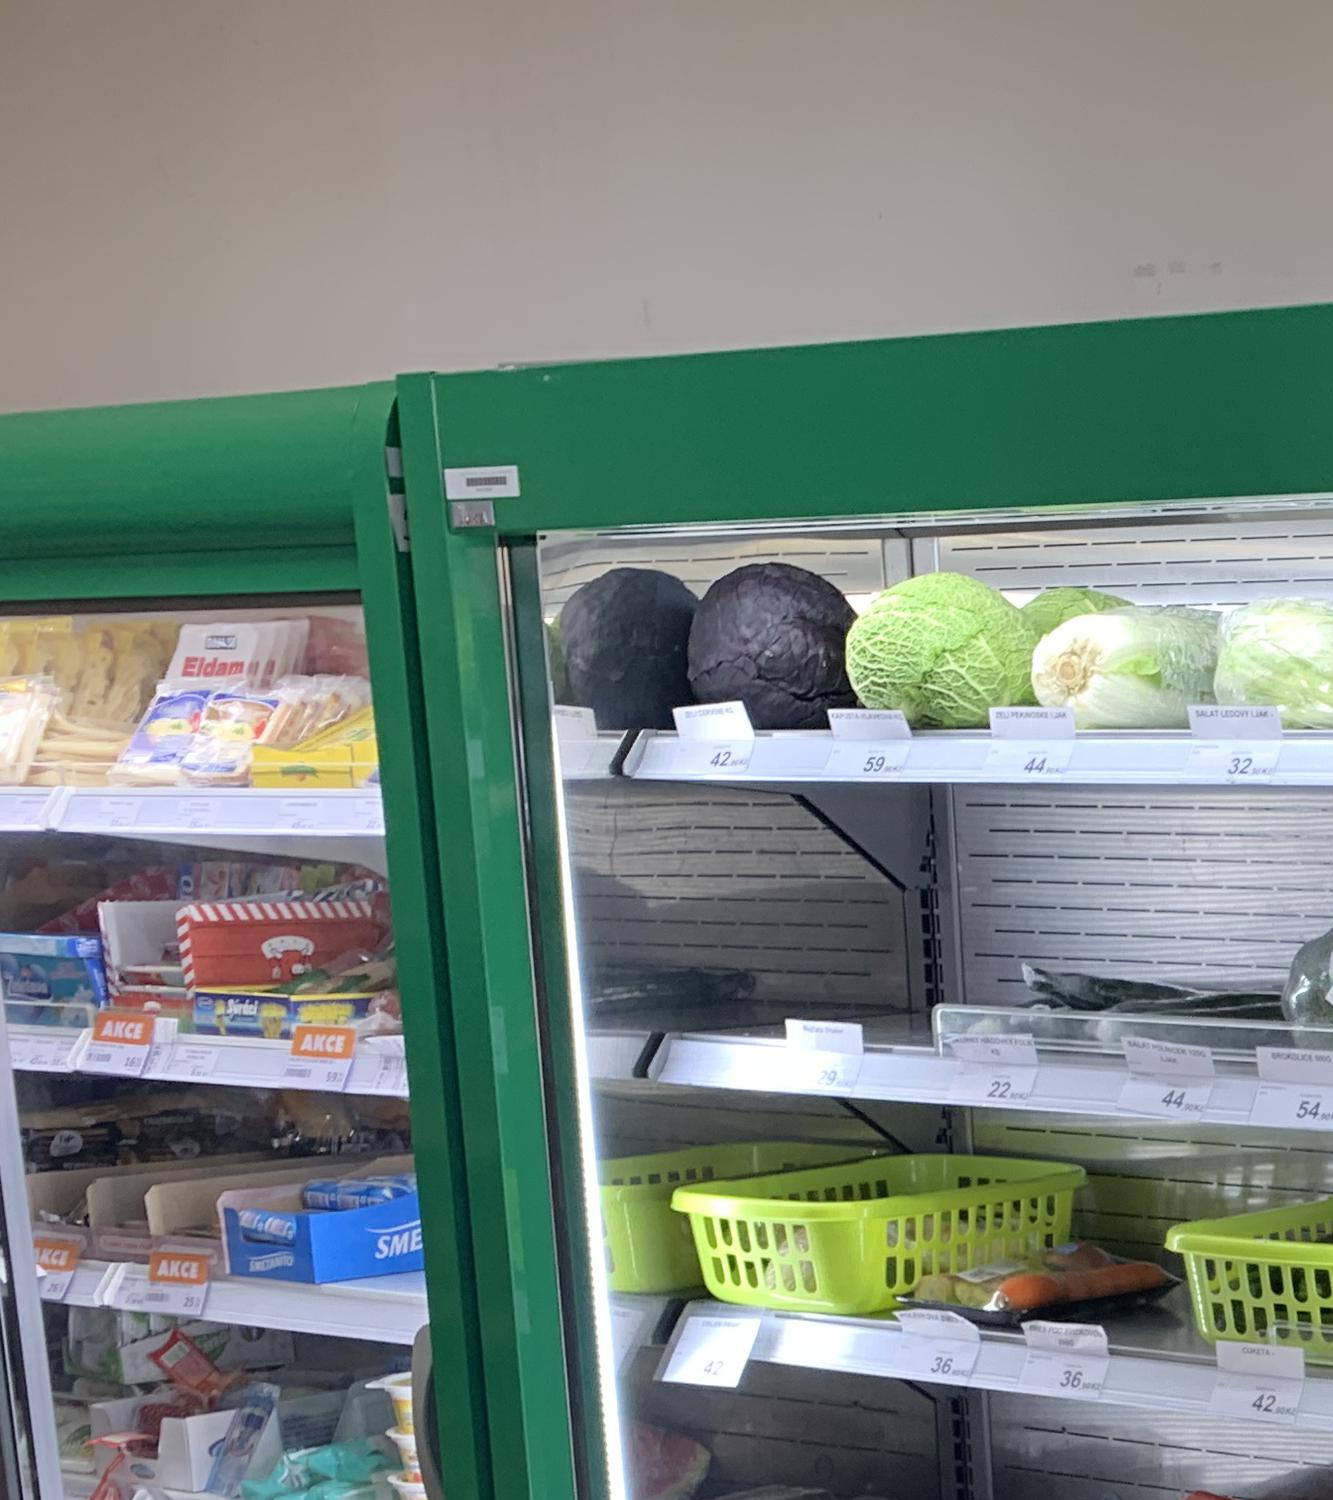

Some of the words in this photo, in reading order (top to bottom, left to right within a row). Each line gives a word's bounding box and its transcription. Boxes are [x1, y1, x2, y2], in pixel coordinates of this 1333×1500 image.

[101, 1020, 145, 1041] AKCE
[299, 1033, 347, 1054] AKCE
[156, 1258, 199, 1279] AKCE
